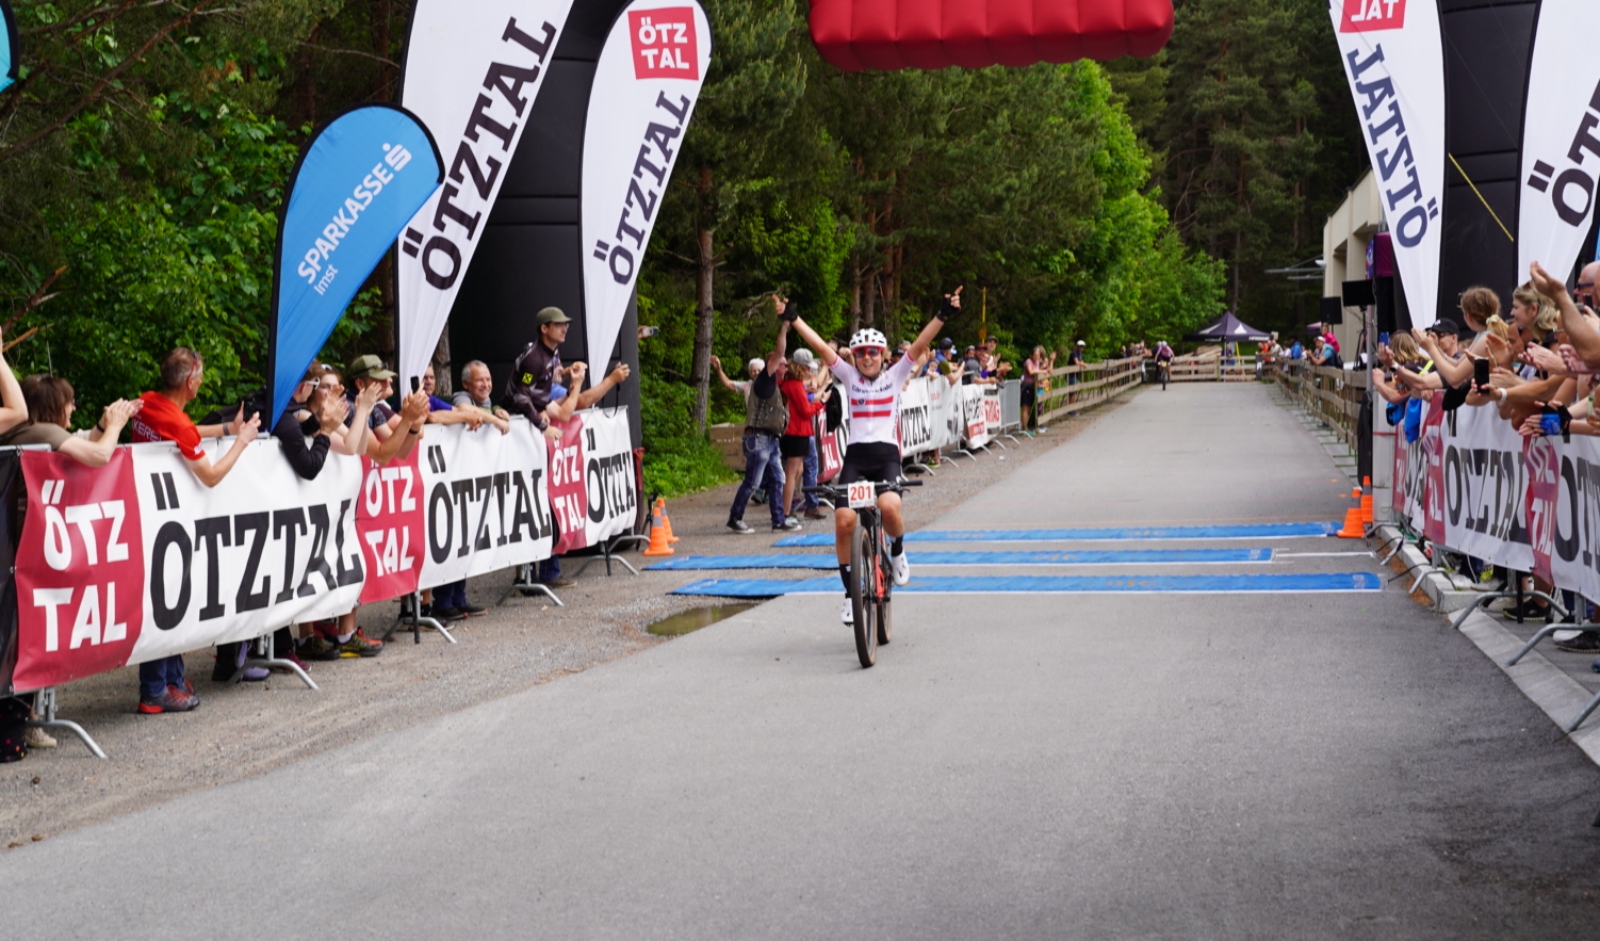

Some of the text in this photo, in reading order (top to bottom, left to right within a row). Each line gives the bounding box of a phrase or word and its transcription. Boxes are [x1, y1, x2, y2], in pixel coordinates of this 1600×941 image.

[638, 16, 689, 45] ÖTZ
[641, 47, 690, 70] TAL
[402, 16, 557, 291] ÖTZTAL
[593, 89, 692, 286] ÖTZTAL
[297, 161, 395, 285] SPARKASSE
[313, 263, 339, 296] Imst
[42, 479, 130, 572] ÖTZ
[428, 444, 553, 565] ÖTZTAL
[554, 492, 585, 535] TAL
[849, 485, 872, 501] 201
[149, 471, 365, 631] ÖTZTAL
[365, 524, 415, 578] TAL
[32, 581, 128, 653] TAL
